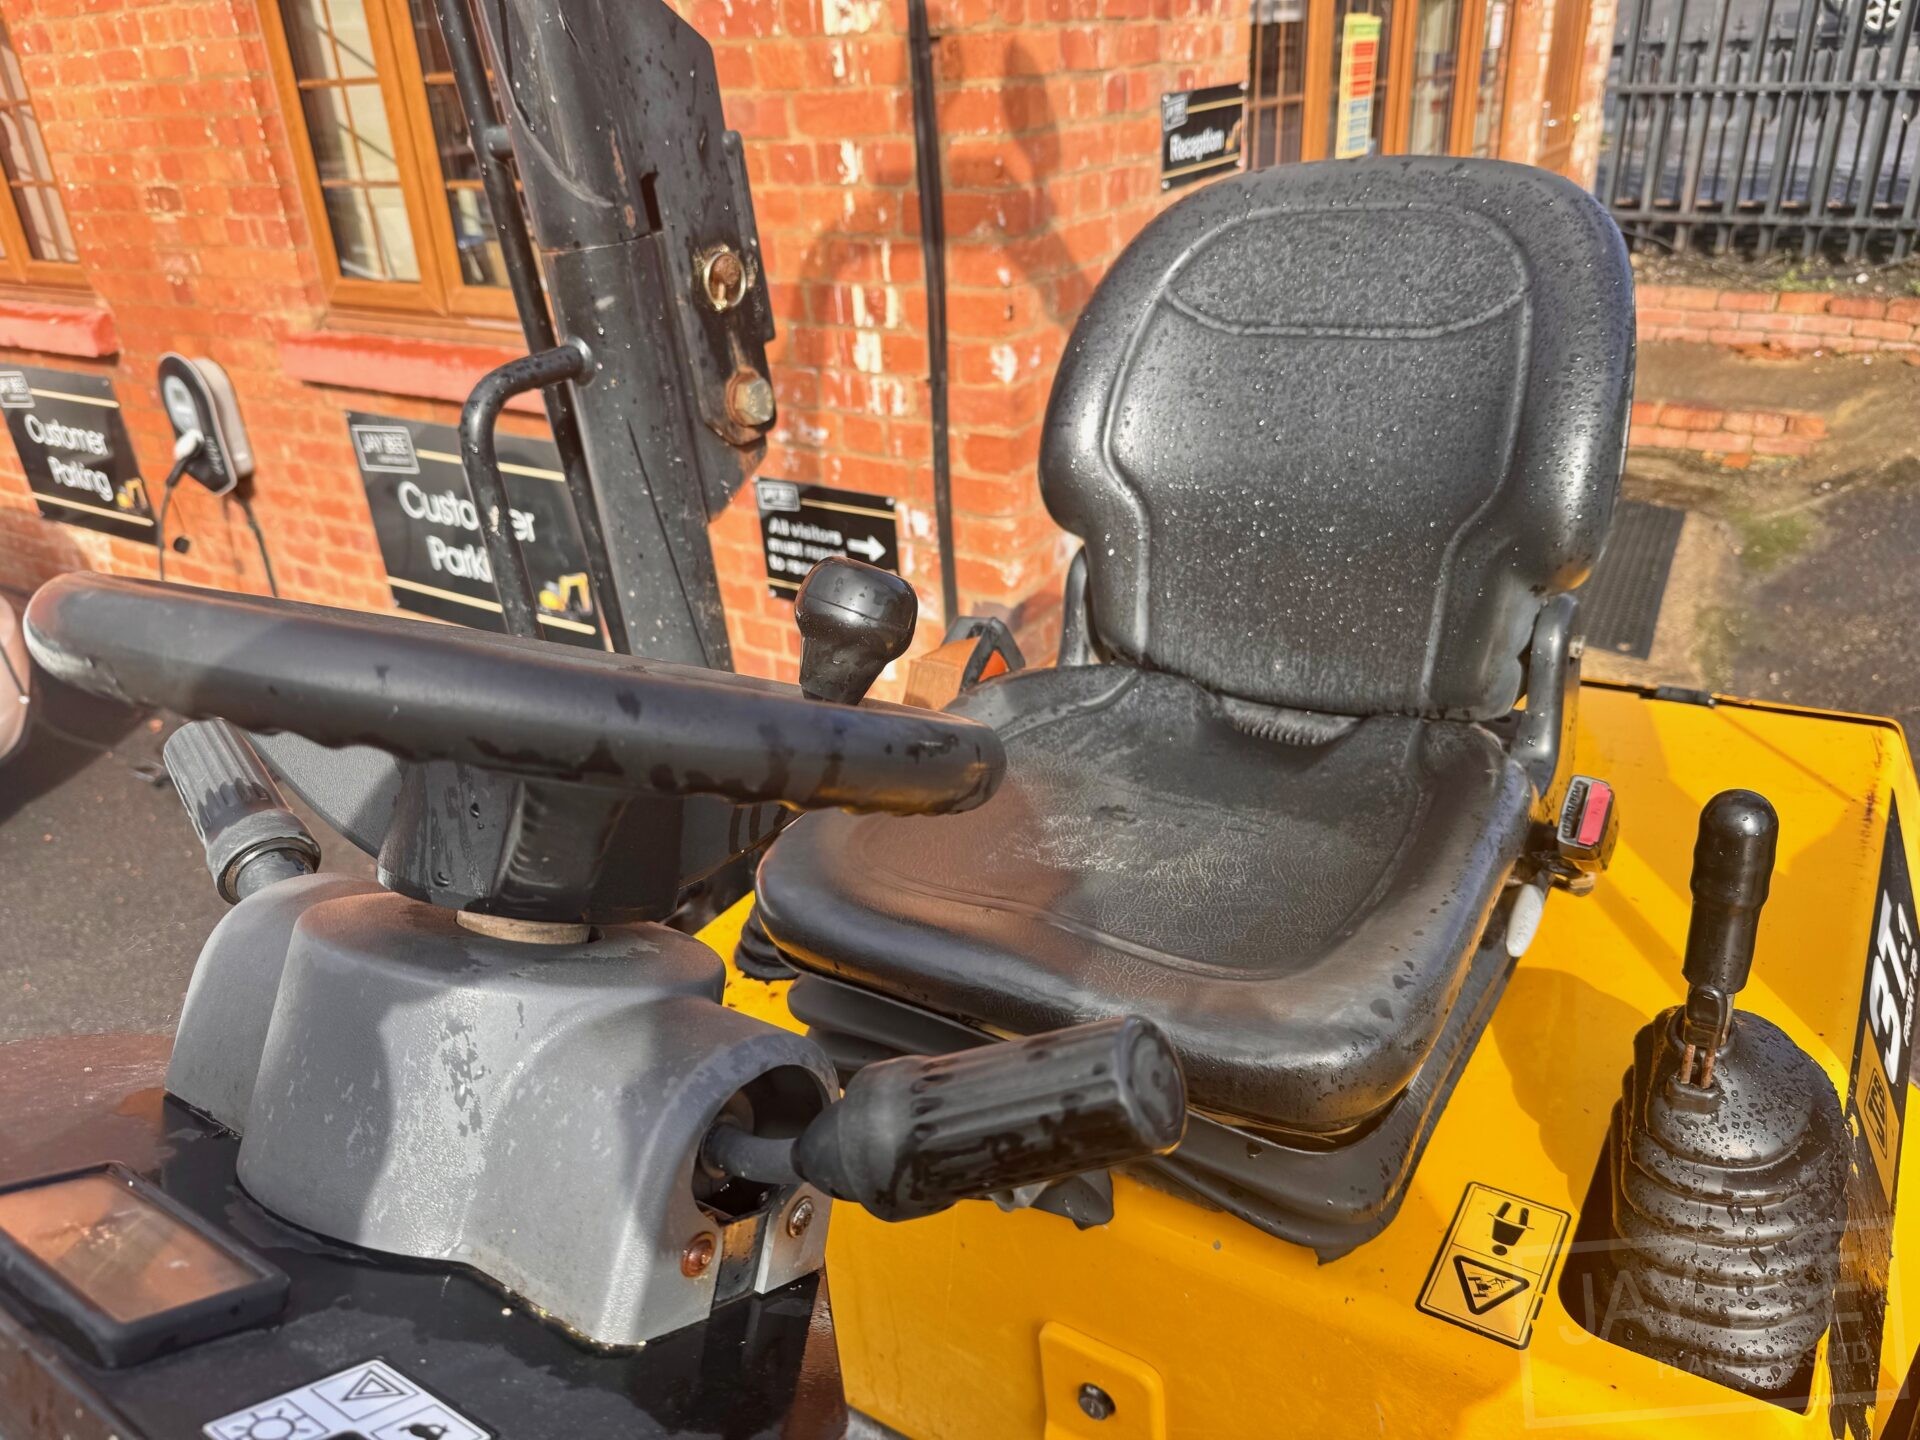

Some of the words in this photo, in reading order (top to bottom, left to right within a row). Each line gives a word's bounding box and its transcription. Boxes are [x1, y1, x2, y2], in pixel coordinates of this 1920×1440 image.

[1169, 127, 1224, 163] Reception
[24, 414, 109, 456] Customer
[47, 456, 113, 502] Parking
[398, 480, 537, 543] Custoer
[1866, 1074, 1886, 1149] JCB
